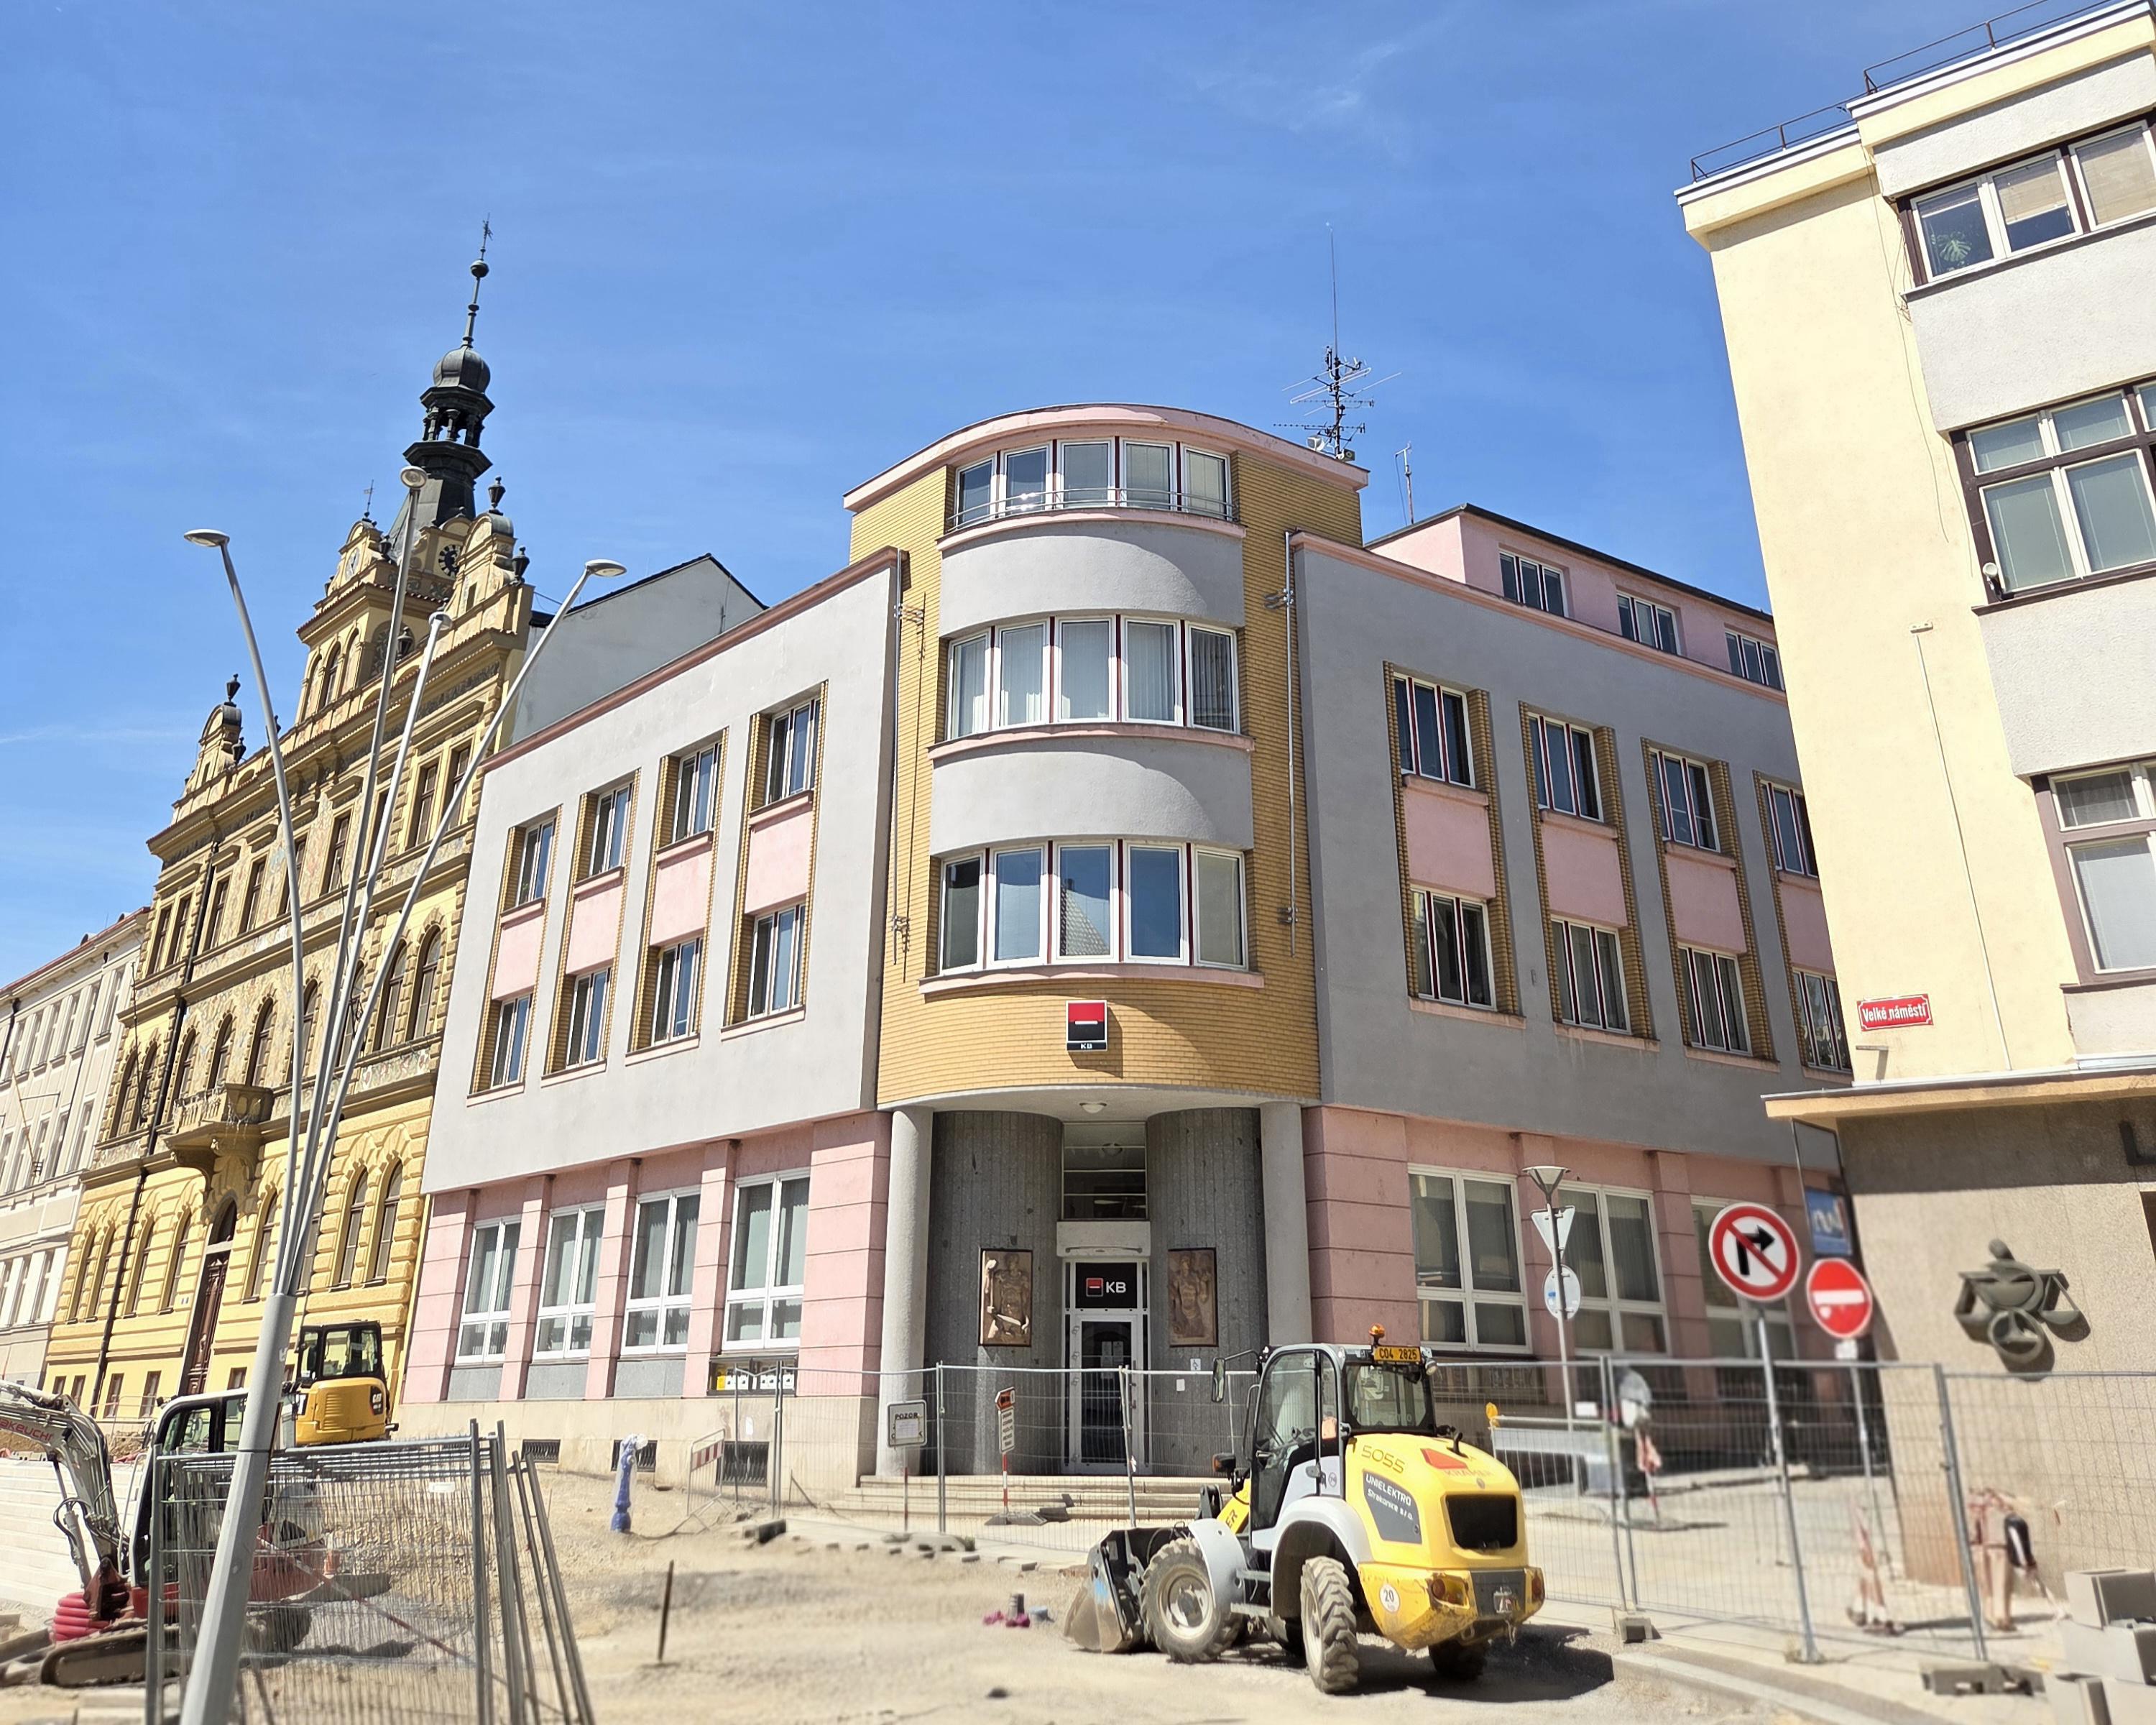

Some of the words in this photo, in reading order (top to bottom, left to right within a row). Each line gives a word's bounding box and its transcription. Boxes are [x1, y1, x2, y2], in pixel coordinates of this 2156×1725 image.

[1862, 1007, 1887, 1022] Velké
[1889, 1003, 1927, 1020] náměstí
[1106, 1282, 1126, 1293] KB
[1366, 1473, 1411, 1506] UNIELEKTRO
[1383, 1588, 1394, 1602] 20
